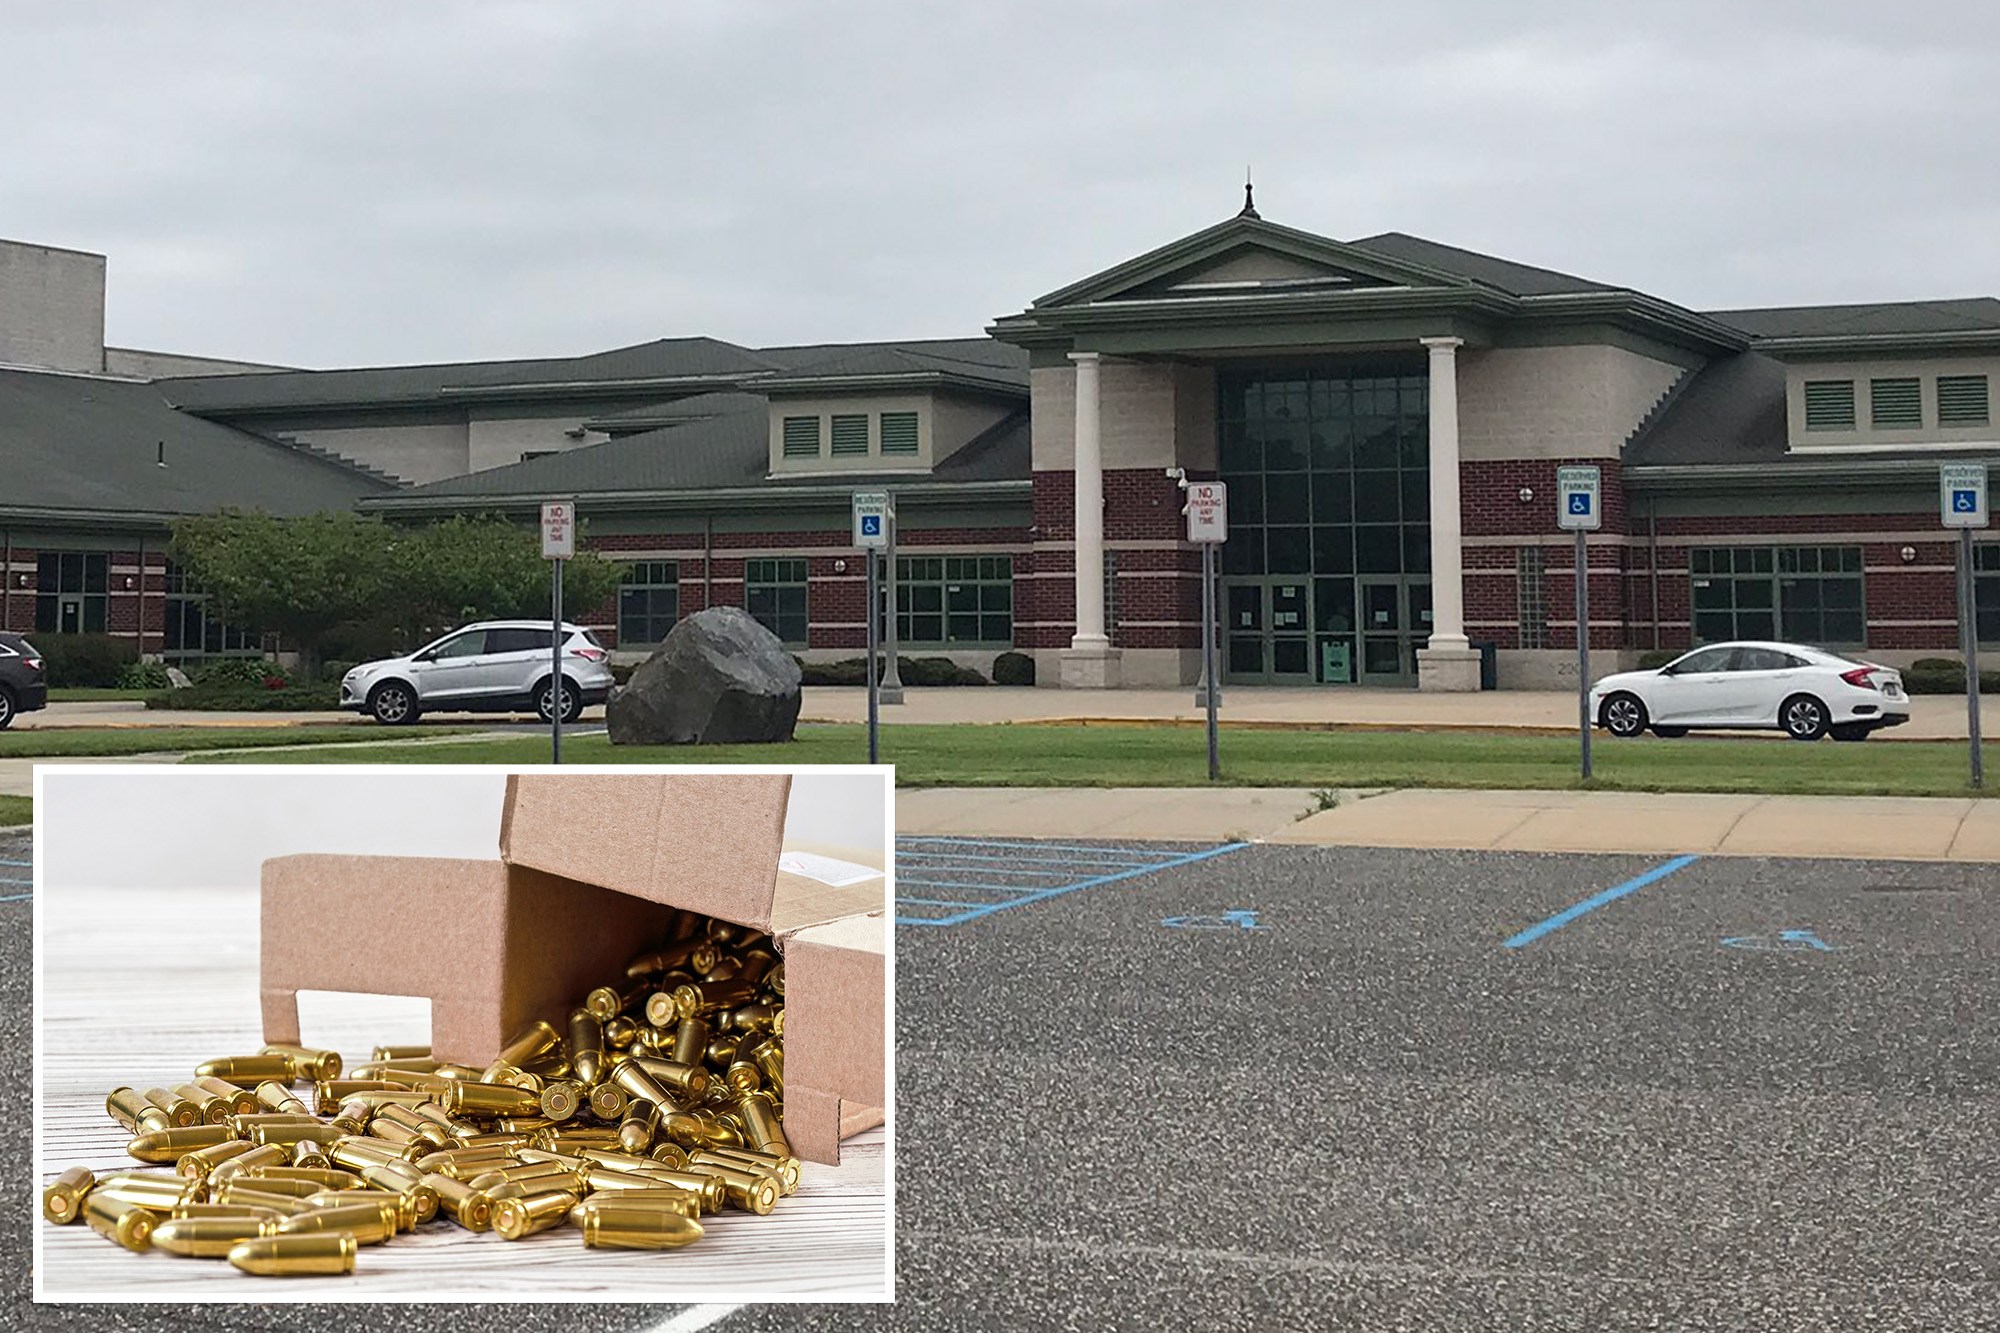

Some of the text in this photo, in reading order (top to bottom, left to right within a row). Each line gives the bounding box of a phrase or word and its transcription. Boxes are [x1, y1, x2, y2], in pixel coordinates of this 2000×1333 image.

[1560, 472, 1598, 480] RESERVED
[1563, 482, 1594, 491] PARKING
[1946, 480, 1981, 488] PARKING
[1198, 487, 1213, 498] NO
[1190, 499, 1221, 507] PARKING
[550, 506, 563, 517] NO
[544, 517, 570, 525] PARKING
